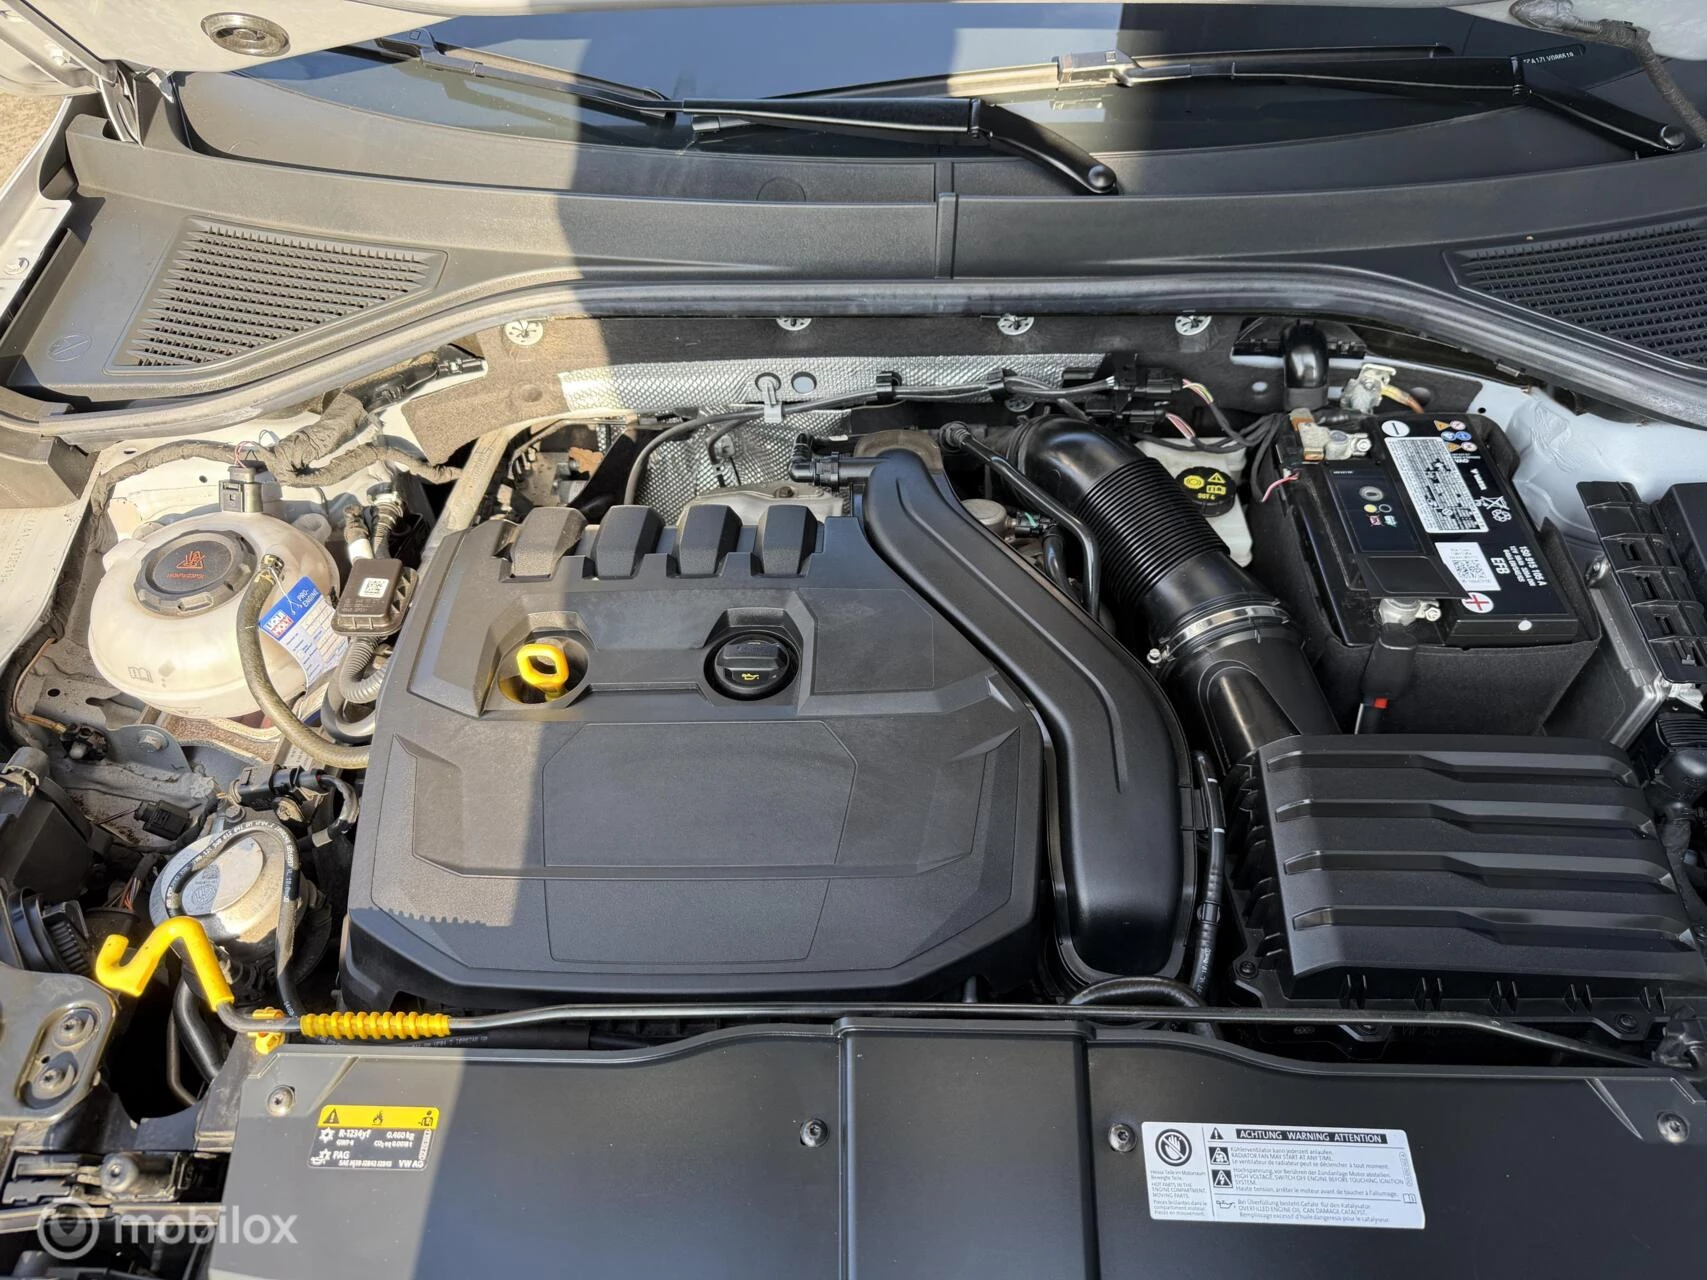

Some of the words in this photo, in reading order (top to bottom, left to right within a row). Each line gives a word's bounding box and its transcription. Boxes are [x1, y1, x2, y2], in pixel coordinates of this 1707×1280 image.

[1491, 558, 1511, 574] EFB
[338, 1129, 372, 1140] R-1234yf
[1239, 1130, 1282, 1139] ACHTUNG
[1286, 1131, 1329, 1140] WARNING
[1333, 1133, 1382, 1142] ATTENTION
[332, 1150, 351, 1160] PAG
[399, 1159, 412, 1168] VW
[412, 1159, 424, 1168] AG
